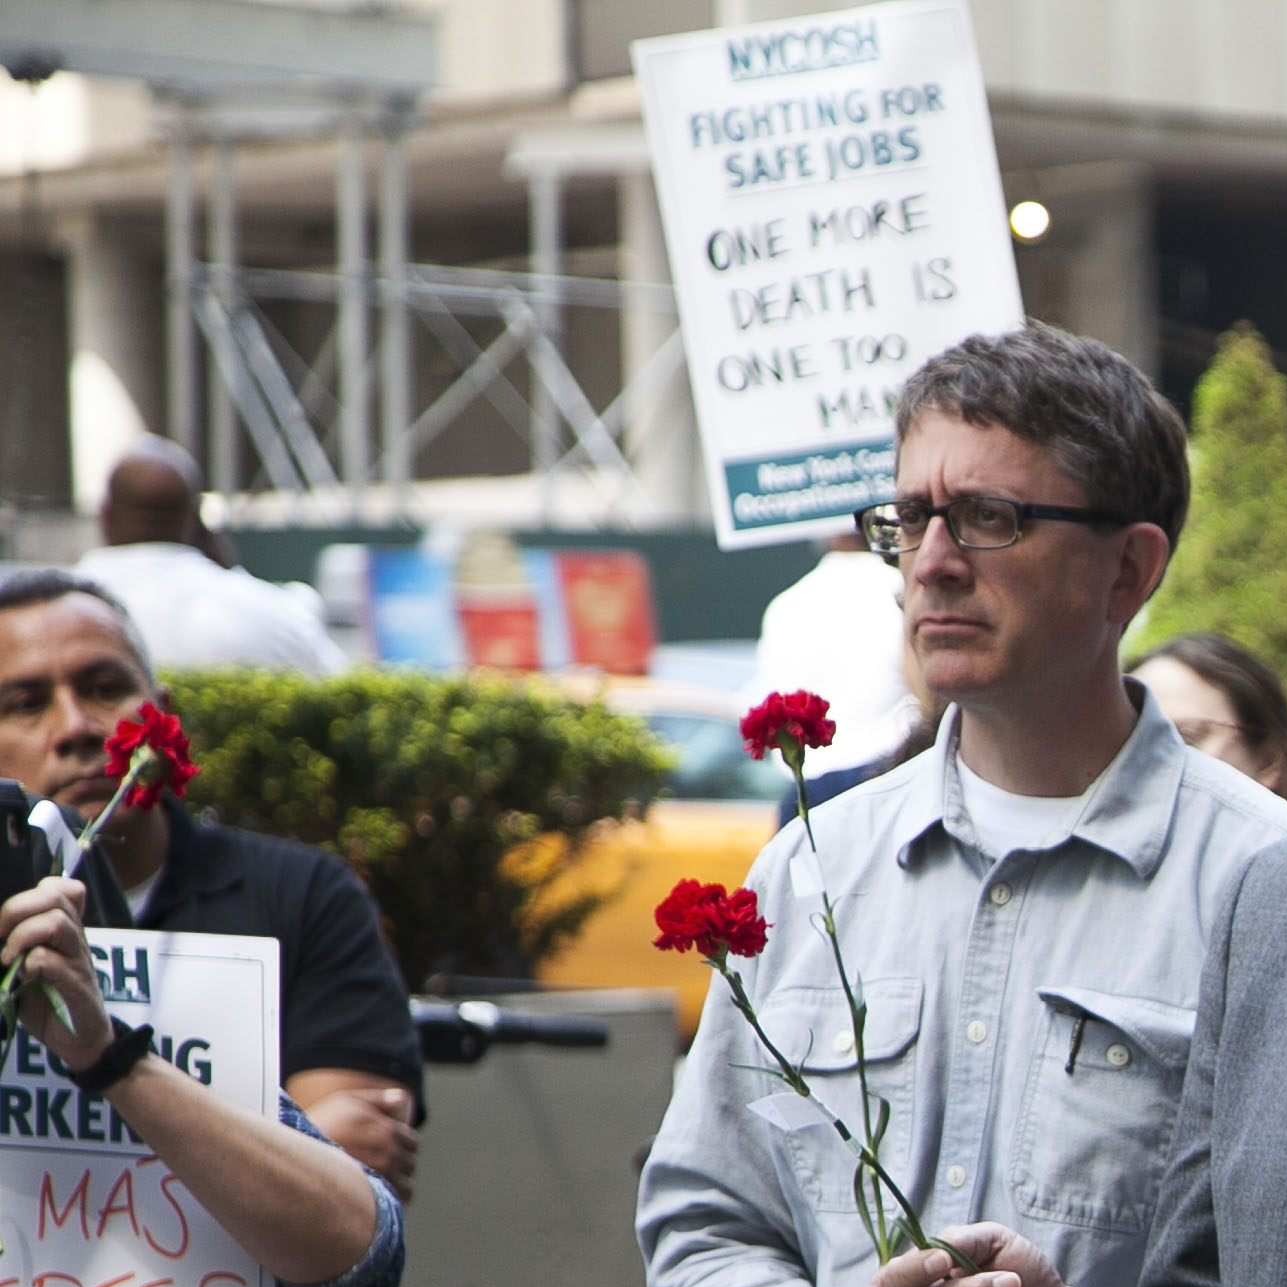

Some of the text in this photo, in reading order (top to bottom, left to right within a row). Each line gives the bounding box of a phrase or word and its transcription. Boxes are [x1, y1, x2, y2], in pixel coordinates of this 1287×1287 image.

[728, 19, 879, 75] NYCOSH
[690, 83, 944, 147] FIGHTING FOR
[724, 127, 922, 187] SAFE JOBS
[706, 193, 930, 271] ONE MORE
[731, 257, 958, 330] DEATH IS
[718, 334, 908, 392] ONE TOO
